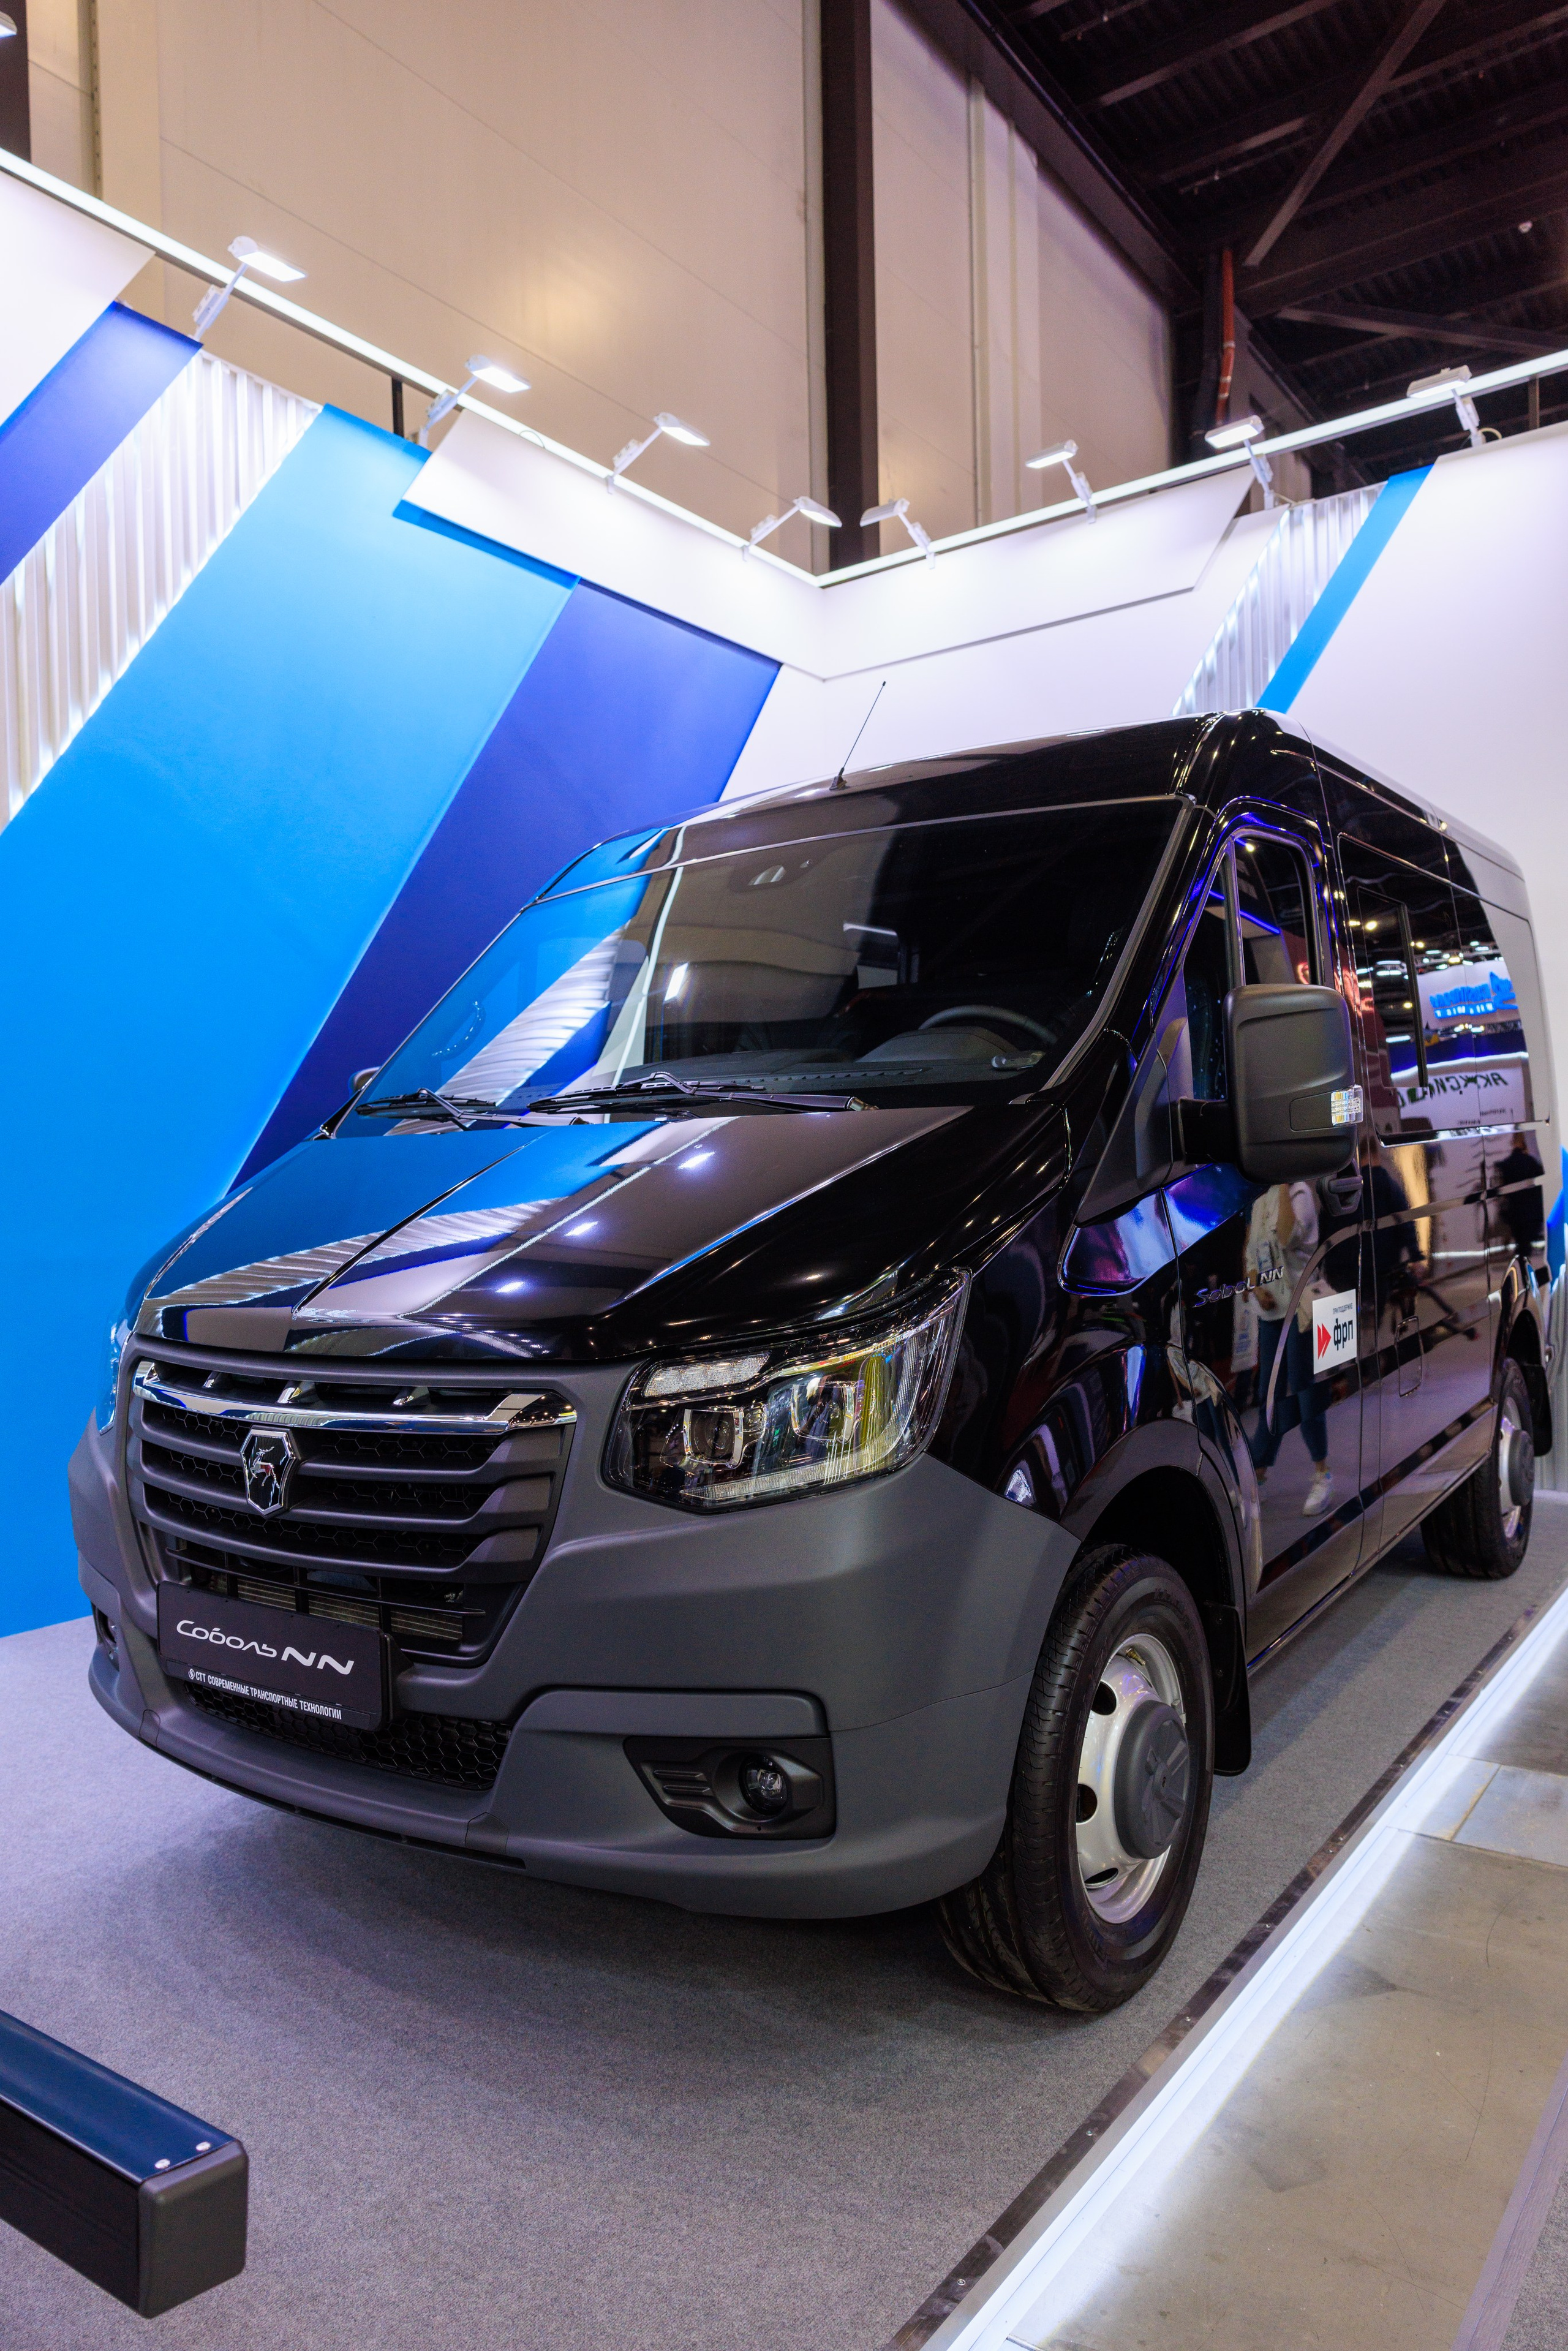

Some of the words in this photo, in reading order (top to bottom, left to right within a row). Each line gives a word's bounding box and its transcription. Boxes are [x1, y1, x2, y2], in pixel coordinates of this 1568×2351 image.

[1257, 1266, 1284, 1286] NN
[1333, 1318, 1354, 1351] фрп
[176, 1620, 277, 1658] Соболь
[281, 1647, 354, 1675] NN
[195, 1671, 206, 1683] СТТ
[208, 1675, 249, 1696] СОВРЕМЕННЫЕ
[250, 1687, 298, 1709] ТРАНСПОРТНЫЕ
[299, 1700, 342, 1719] ТЕХНОЛОГИИ
